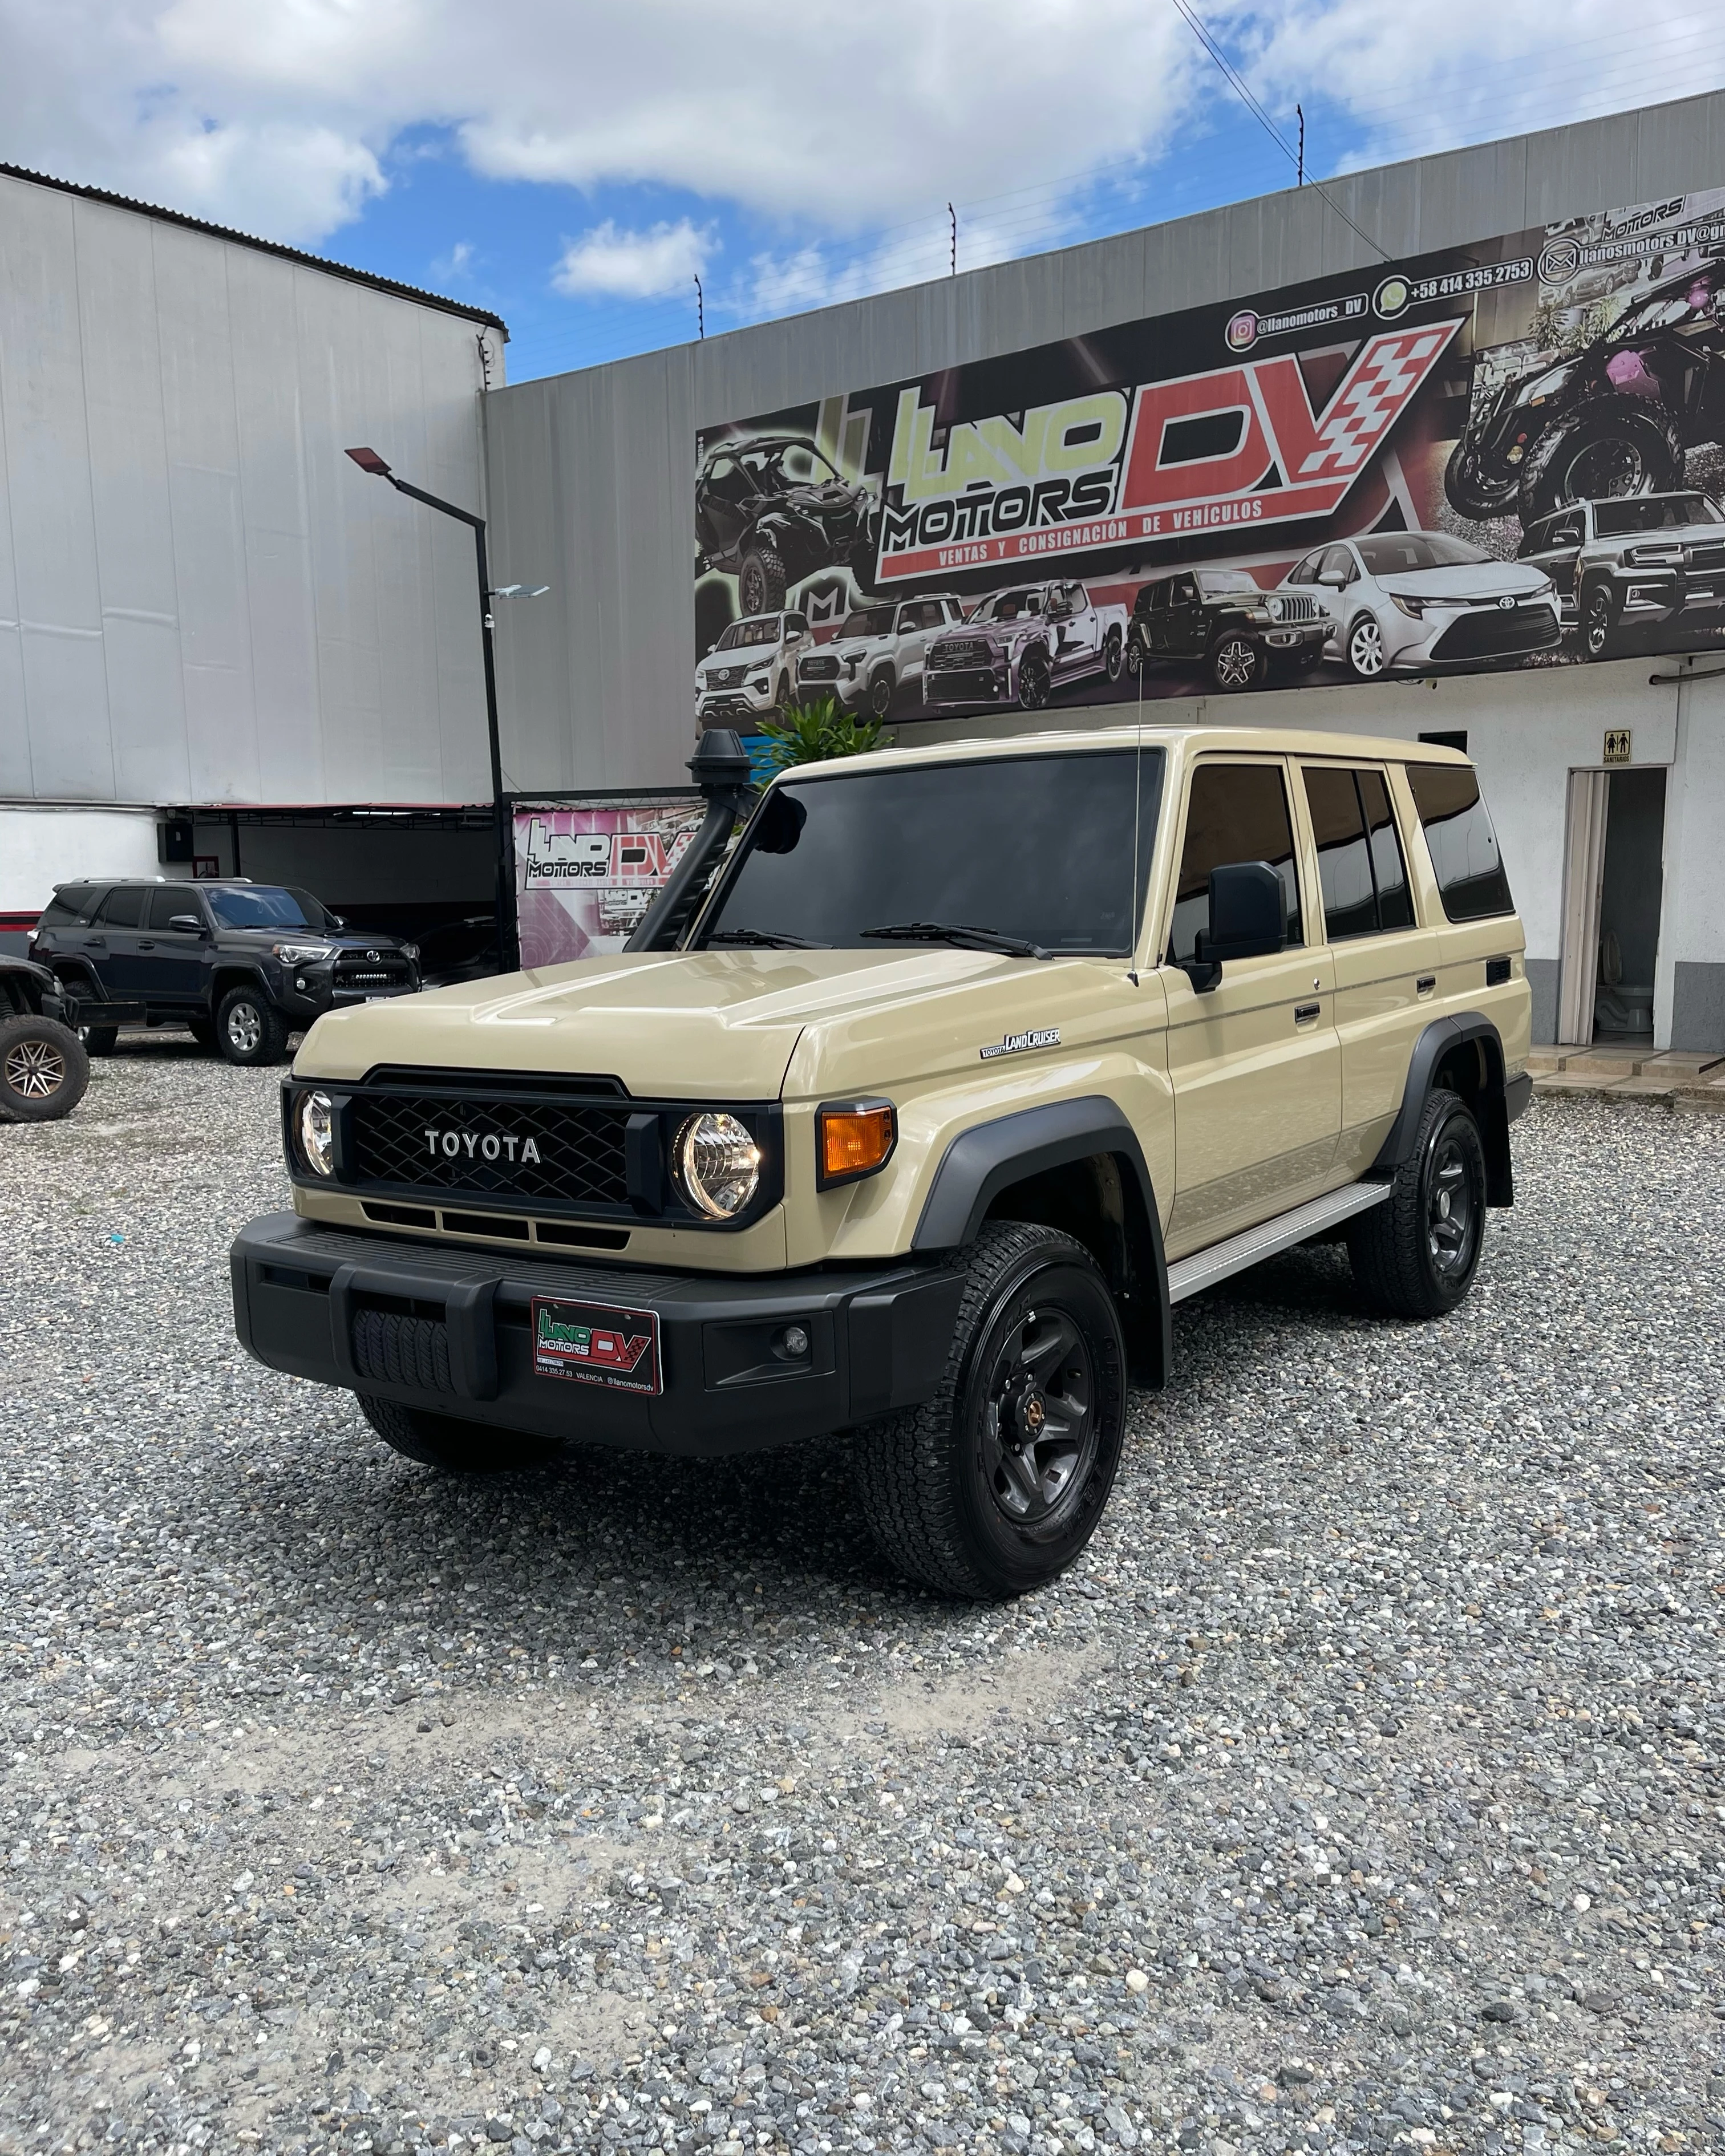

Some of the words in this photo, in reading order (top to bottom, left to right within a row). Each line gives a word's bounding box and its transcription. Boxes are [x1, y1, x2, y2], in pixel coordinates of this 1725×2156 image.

[1602, 197, 1684, 241] MOTORS
[1411, 281, 1438, 298] +58
[1440, 275, 1463, 293] 414
[1122, 317, 1466, 509] DV
[882, 471, 1115, 552] MOTORS
[939, 544, 987, 566] VENTAS
[998, 541, 1006, 556] Y
[1019, 520, 1127, 553] CONSIGNACIÓN
[1143, 516, 1160, 533] DE
[1173, 500, 1262, 529] VEHÍCULOS
[944, 642, 974, 651] TOYOTA
[528, 861, 607, 878] MOTORS
[983, 1046, 1005, 1056] TOYOTA
[424, 1129, 541, 1164] TOYOTA
[539, 1339, 589, 1356] MOTORS
[591, 1329, 651, 1362] DV
[576, 1372, 603, 1383] VALENCIA
